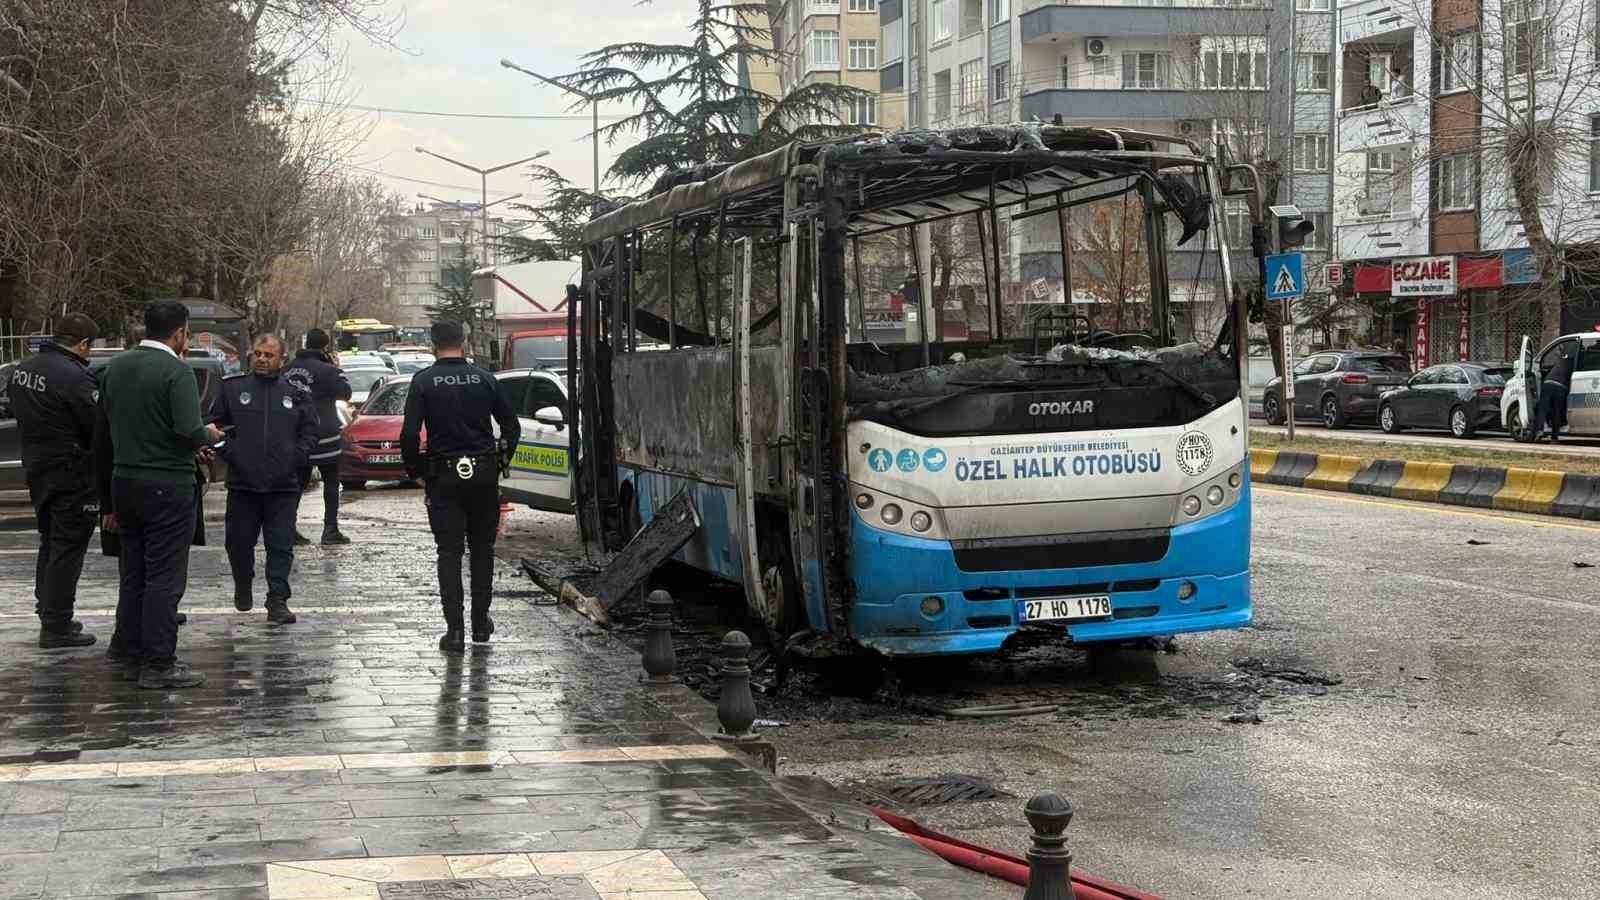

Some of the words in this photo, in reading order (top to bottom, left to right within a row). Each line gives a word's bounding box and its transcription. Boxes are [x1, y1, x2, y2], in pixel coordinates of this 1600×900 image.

[1328, 268, 1338, 281] E
[1393, 260, 1451, 281] ECZANE
[12, 370, 47, 392] POLİS
[1028, 400, 1094, 416] OTOKAR
[990, 445, 1034, 456] GAZİANTEP
[1037, 441, 1085, 454] BÜYÜKŞEHİR
[1087, 440, 1129, 451] BELEDİYESİ
[1188, 434, 1200, 446] HO
[1184, 448, 1206, 460] 1178
[955, 457, 1008, 481] ÖZEL
[1014, 456, 1067, 479] HALK
[1072, 447, 1161, 476] OTOBÜSÜ
[1026, 602, 1042, 618] 27
[1050, 600, 1068, 617] HO
[1077, 598, 1110, 615] 1178
